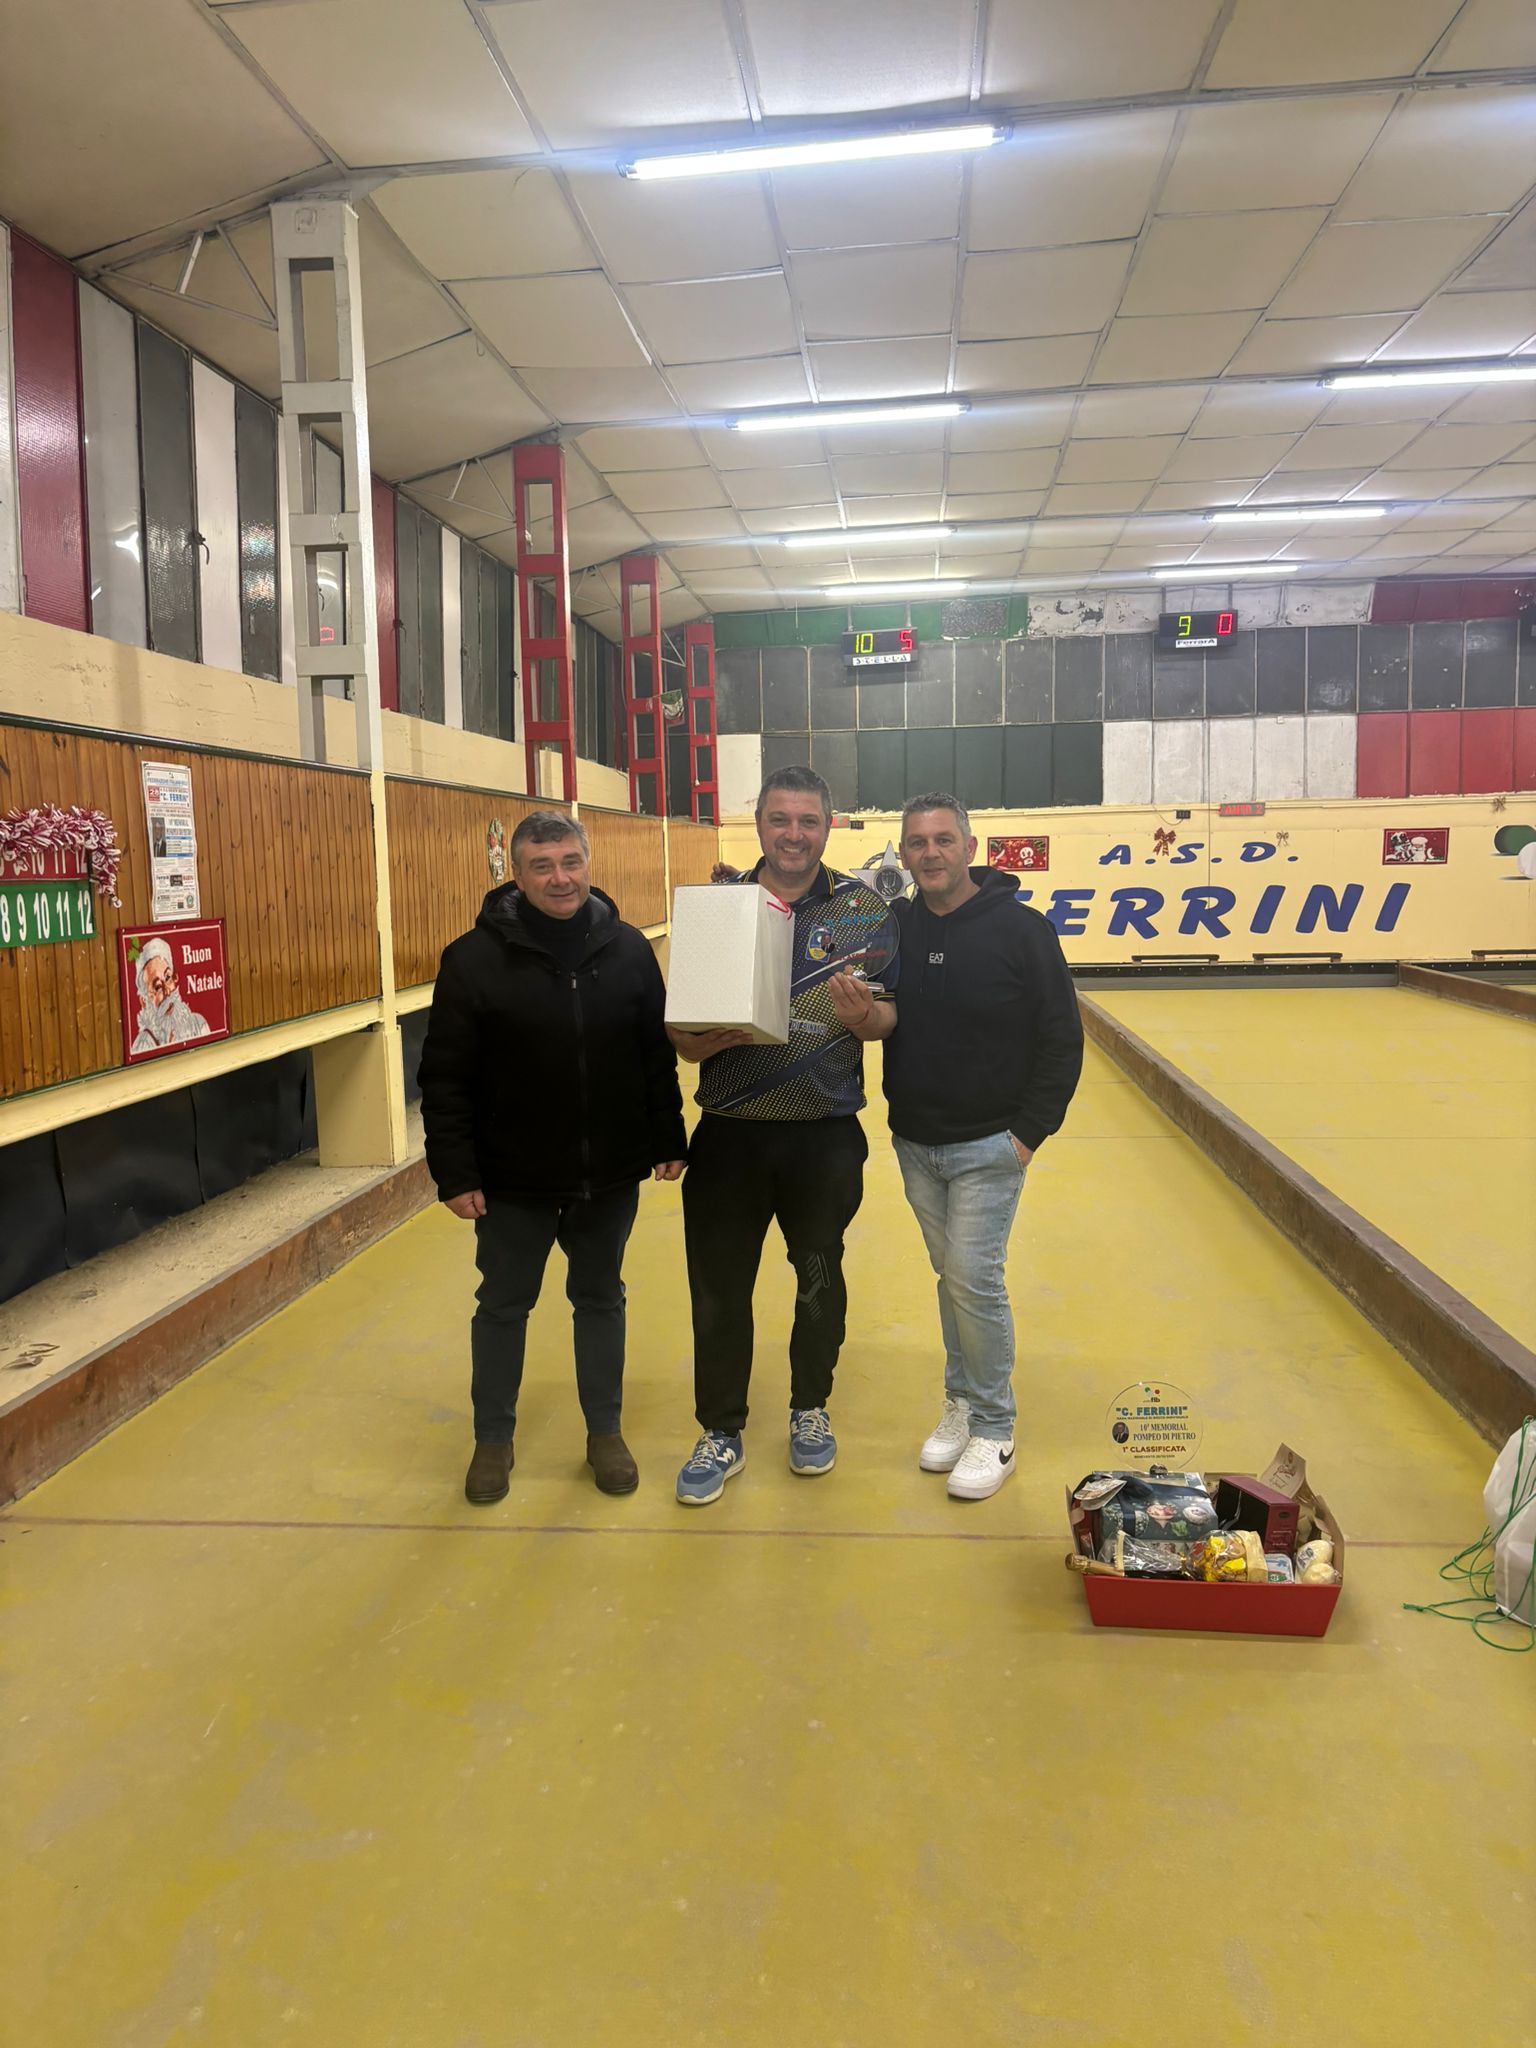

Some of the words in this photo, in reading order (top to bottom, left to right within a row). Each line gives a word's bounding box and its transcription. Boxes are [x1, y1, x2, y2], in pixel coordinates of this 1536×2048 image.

[1178, 615, 1191, 636] 9
[1218, 613, 1232, 634] 0
[856, 633, 873, 653] 10
[900, 630, 912, 651] 5
[0, 894, 11, 943] 8
[16, 893, 27, 942] 9
[33, 892, 50, 939] 10
[56, 891, 72, 937] 11
[77, 890, 94, 935] 12
[1014, 882, 1412, 940] ERRINI
[181, 944, 213, 965] Buon
[929, 952, 944, 963] EA7
[186, 971, 224, 995] Natale
[1116, 1407, 1133, 1416] "C.
[1137, 1406, 1188, 1416] FERRINI"
[1133, 1433, 1161, 1441] POMPEO
[1171, 1432, 1196, 1440] PIETRO
[1151, 1422, 1188, 1431] MEMORIAL
